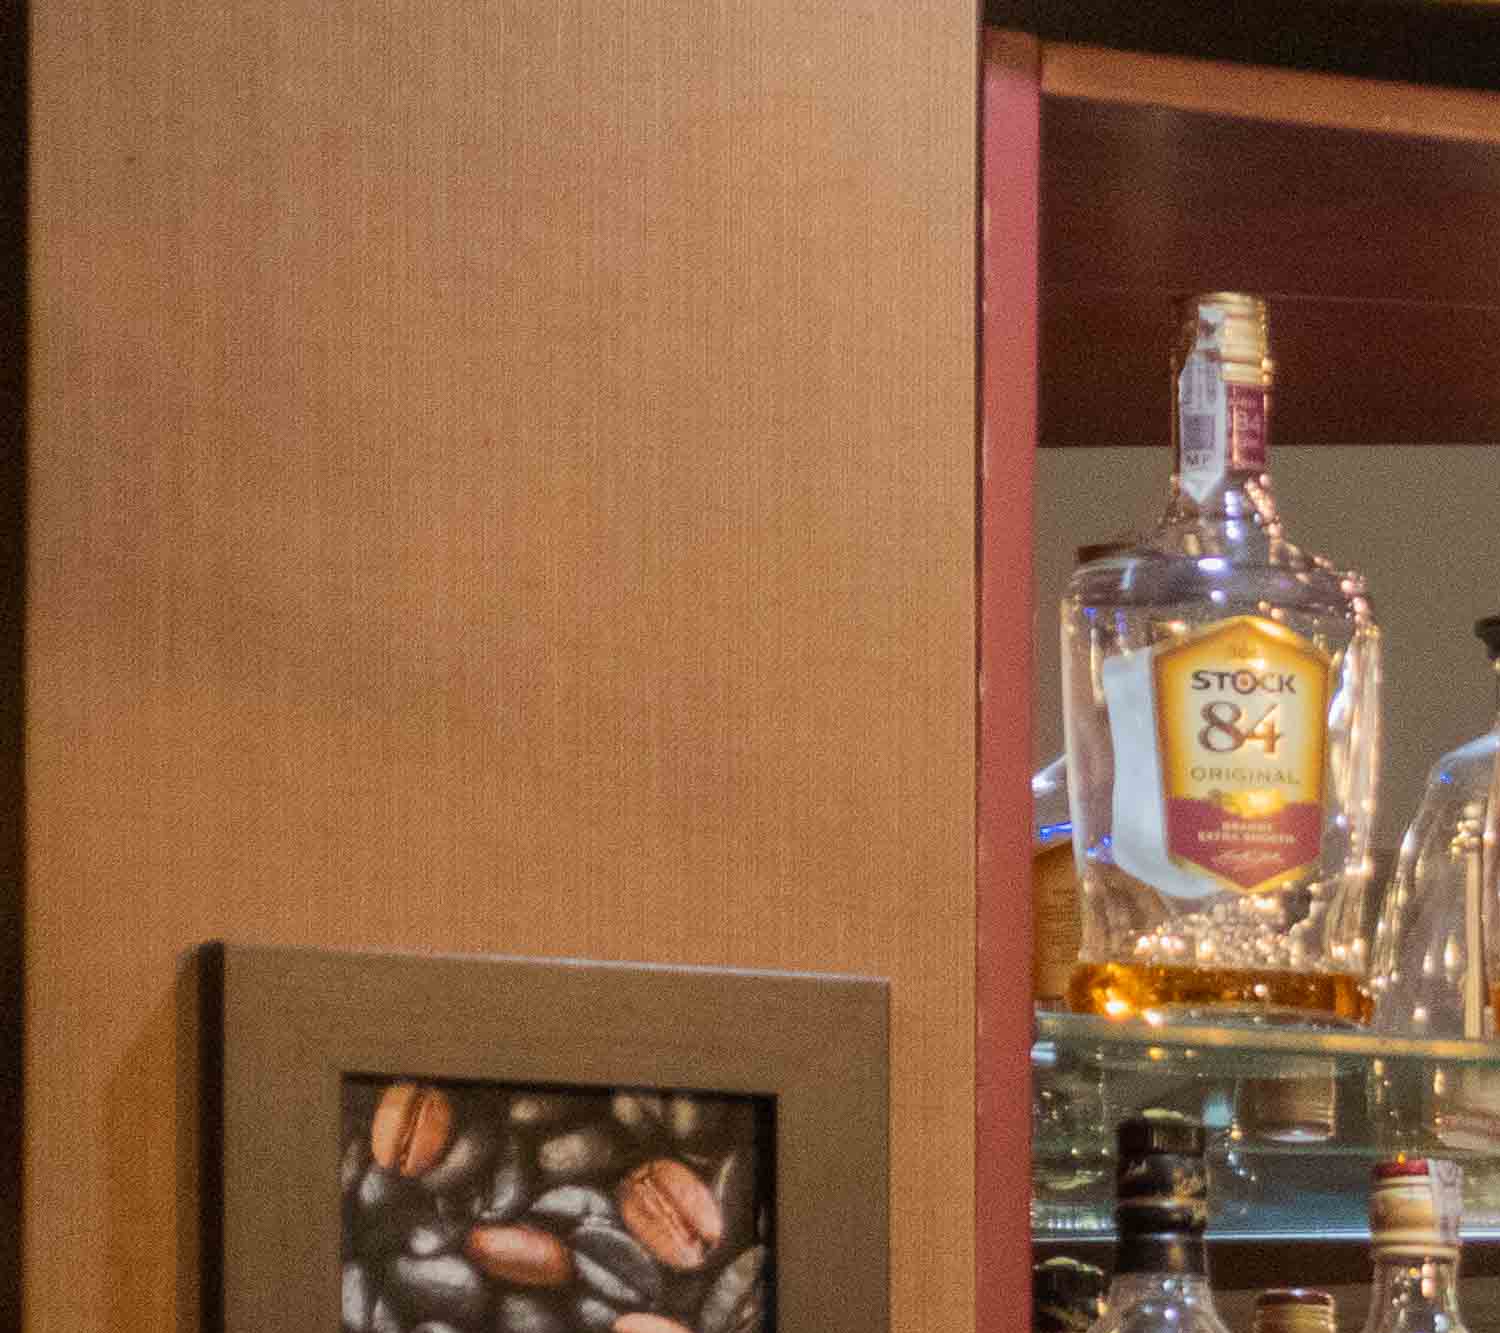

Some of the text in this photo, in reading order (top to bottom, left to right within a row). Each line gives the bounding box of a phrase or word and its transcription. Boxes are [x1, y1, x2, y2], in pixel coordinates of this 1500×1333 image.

[1190, 668, 1297, 695] STOCK
[1197, 700, 1284, 753] 84
[1190, 766, 1300, 785] ORIGINAL
